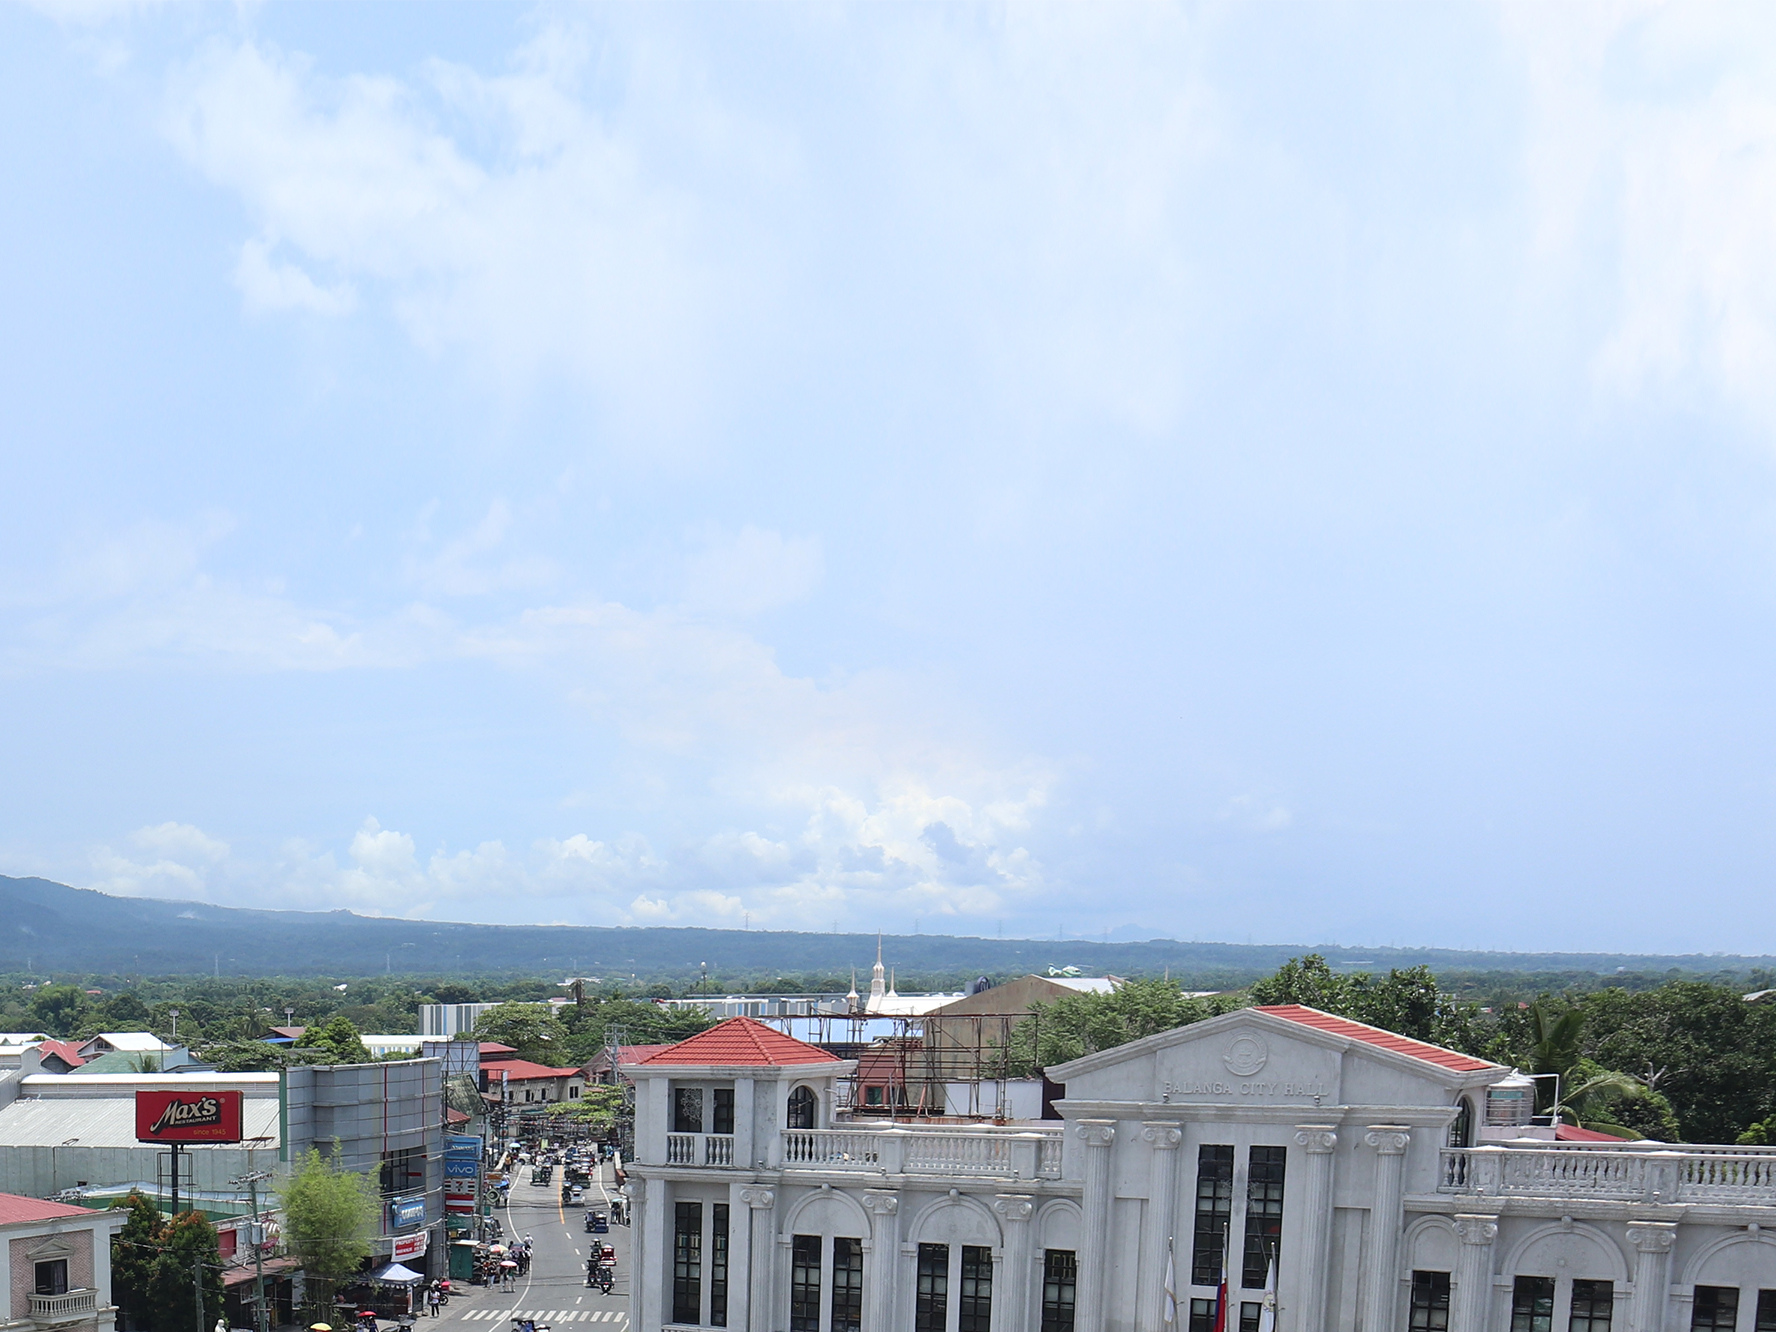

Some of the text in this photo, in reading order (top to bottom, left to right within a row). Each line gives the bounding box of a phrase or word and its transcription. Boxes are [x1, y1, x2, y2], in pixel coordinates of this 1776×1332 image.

[1164, 1081, 1329, 1097] BALANGA CITY HALL
[174, 1115, 217, 1125] RESTAURANT
[212, 1128, 226, 1136] 1945
